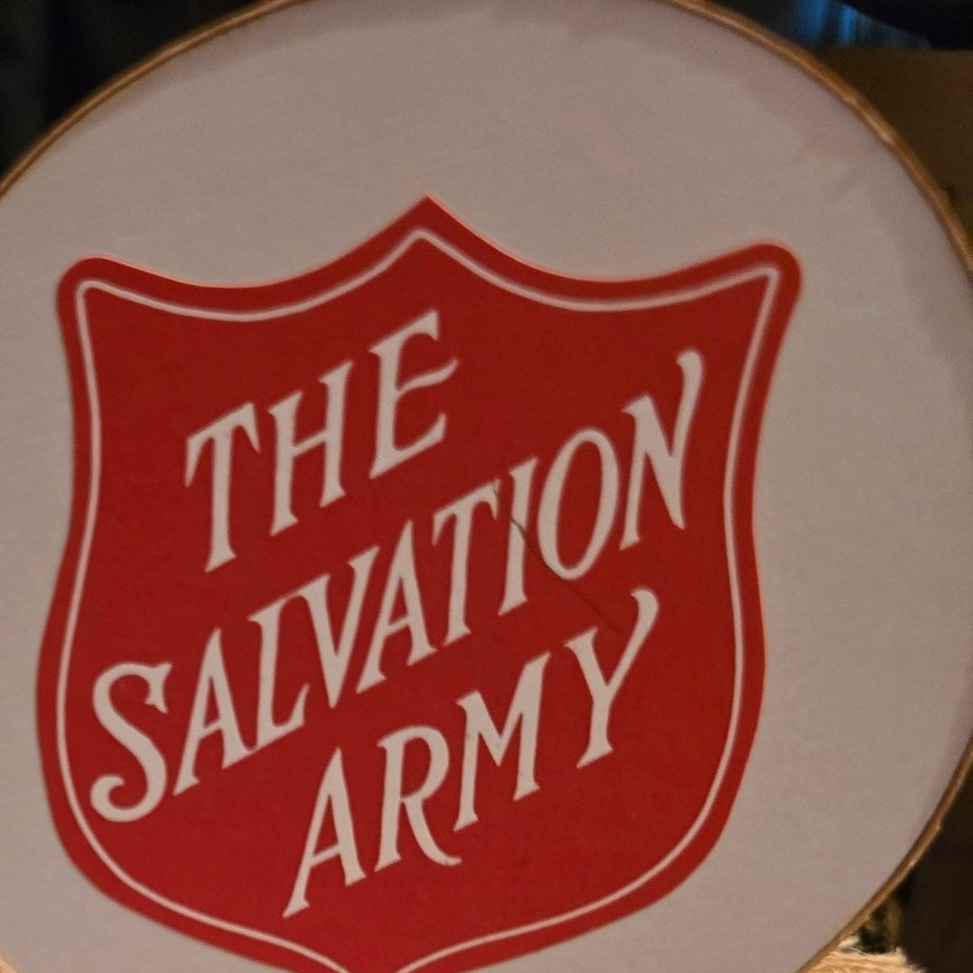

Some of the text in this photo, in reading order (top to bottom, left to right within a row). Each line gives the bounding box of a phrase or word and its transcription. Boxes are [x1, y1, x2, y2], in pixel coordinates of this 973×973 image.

[89, 348, 703, 823] SALVATION
[184, 309, 459, 573] THE
[283, 587, 658, 918] ARMY
